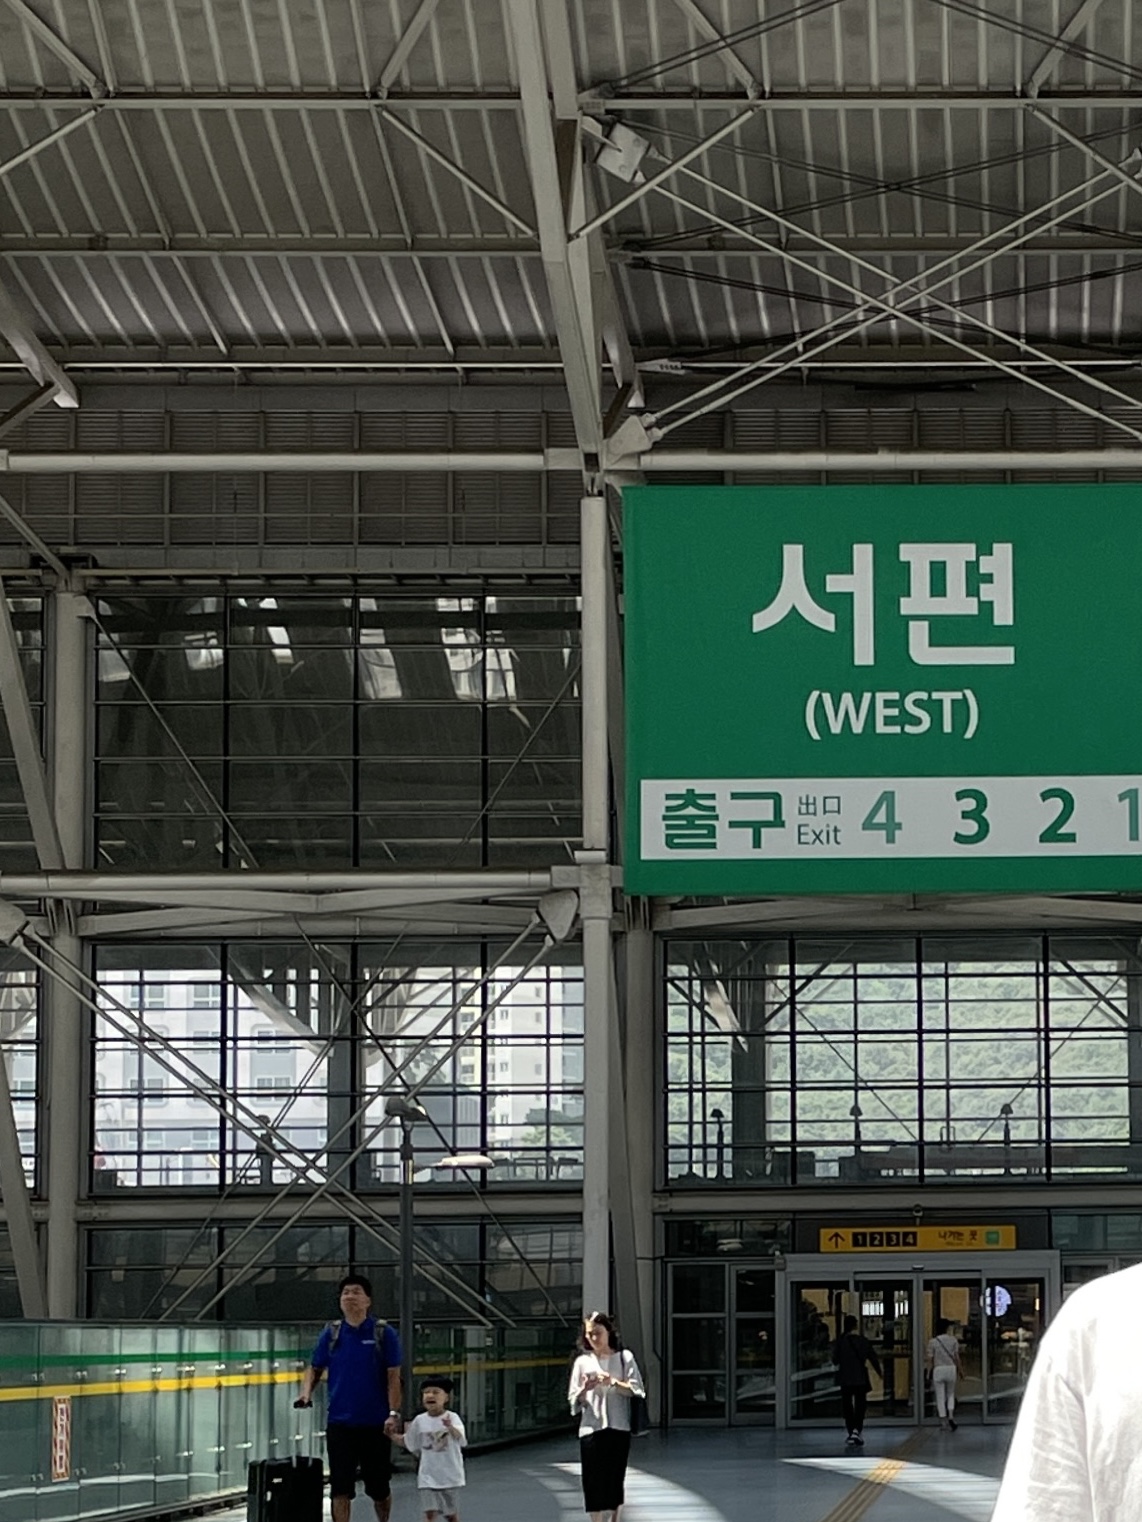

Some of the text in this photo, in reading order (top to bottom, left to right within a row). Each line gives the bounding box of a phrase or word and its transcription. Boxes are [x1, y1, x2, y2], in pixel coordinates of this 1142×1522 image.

[752, 542, 1016, 667] 서편
[805, 688, 979, 741] (WEST)
[661, 788, 786, 850] 출구
[797, 794, 842, 817] 出口
[861, 787, 1140, 846] 4 3 2 1
[797, 823, 842, 847] Exit
[873, 1233, 881, 1245] 2
[889, 1233, 898, 1245] 3
[905, 1233, 914, 1245] 4
